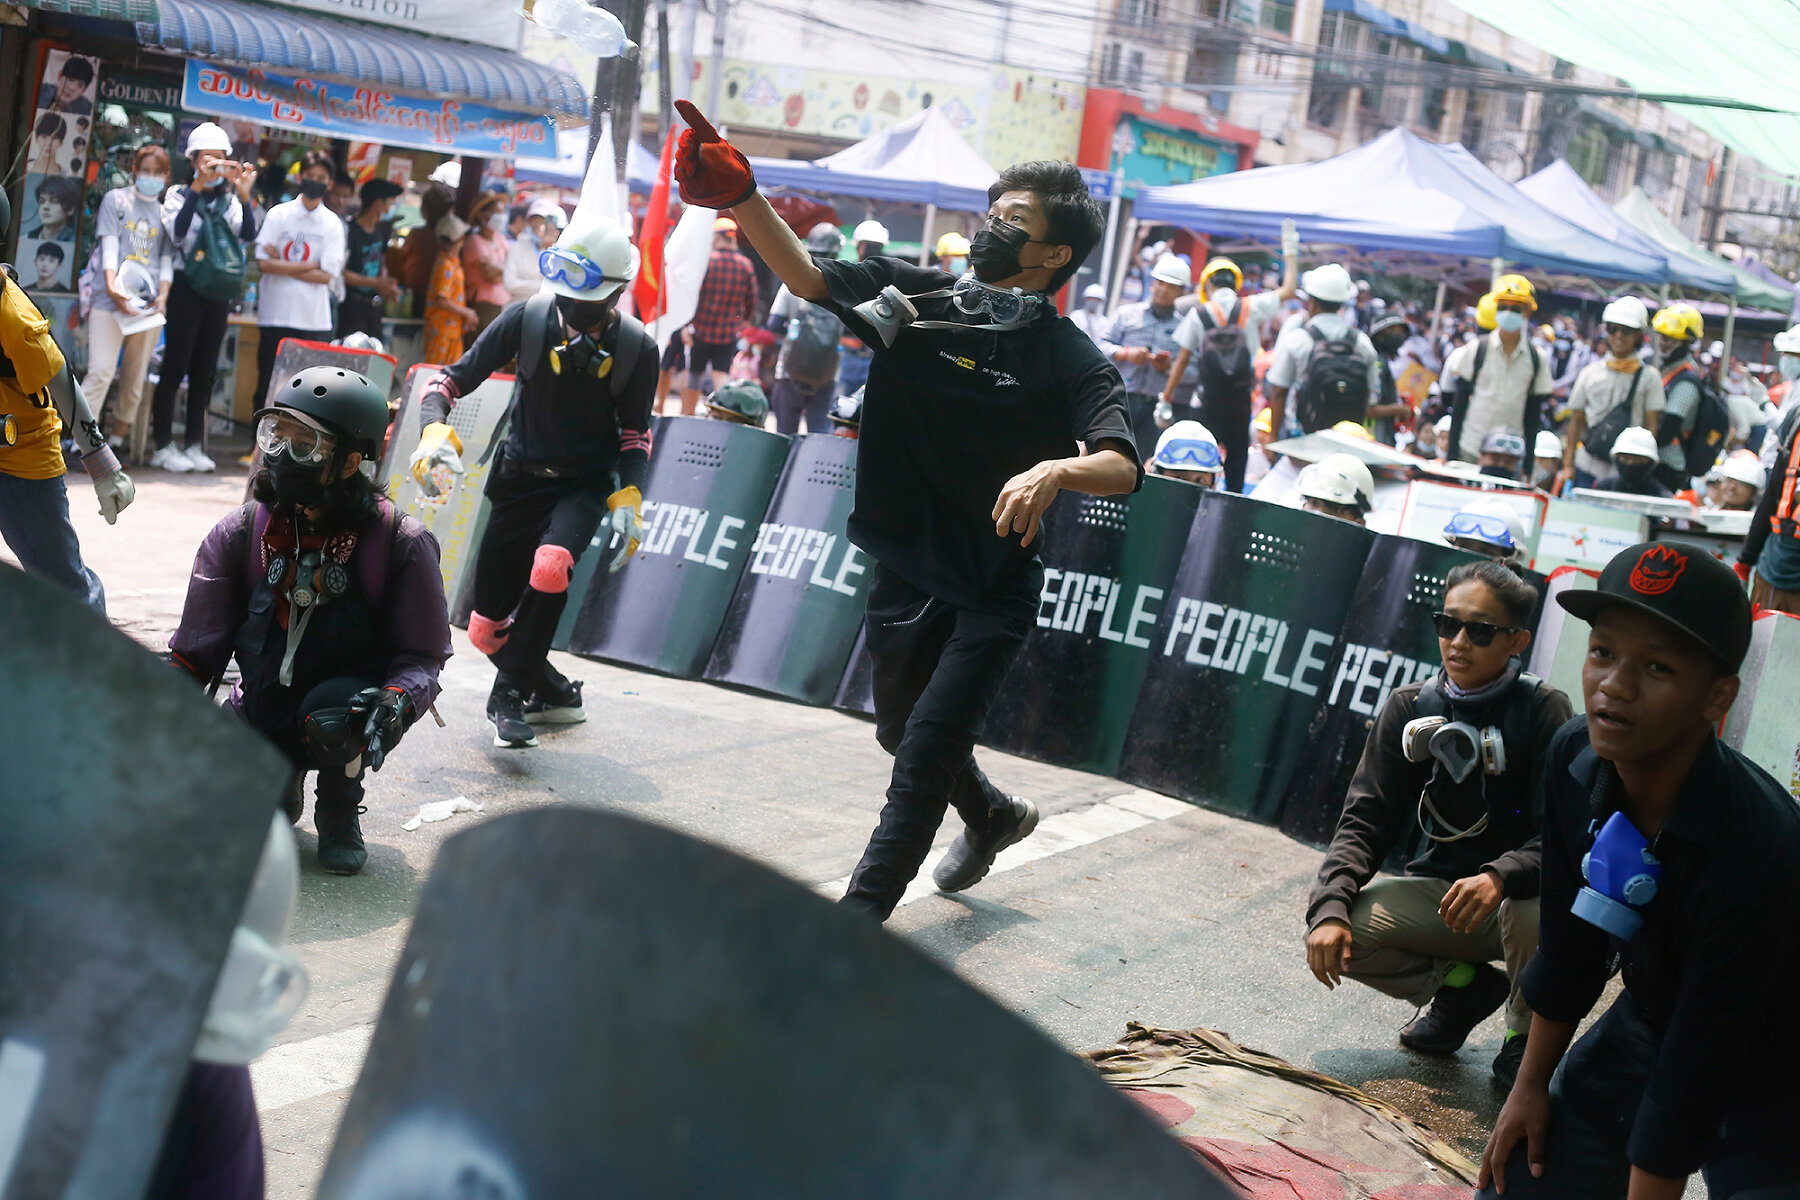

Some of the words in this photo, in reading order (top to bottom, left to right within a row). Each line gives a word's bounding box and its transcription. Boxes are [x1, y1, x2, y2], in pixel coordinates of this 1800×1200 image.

[328, 0, 418, 20] alon
[609, 500, 746, 571] EOPLE
[1037, 567, 1164, 649] EOPLE
[1163, 596, 1335, 697] PEOPLE
